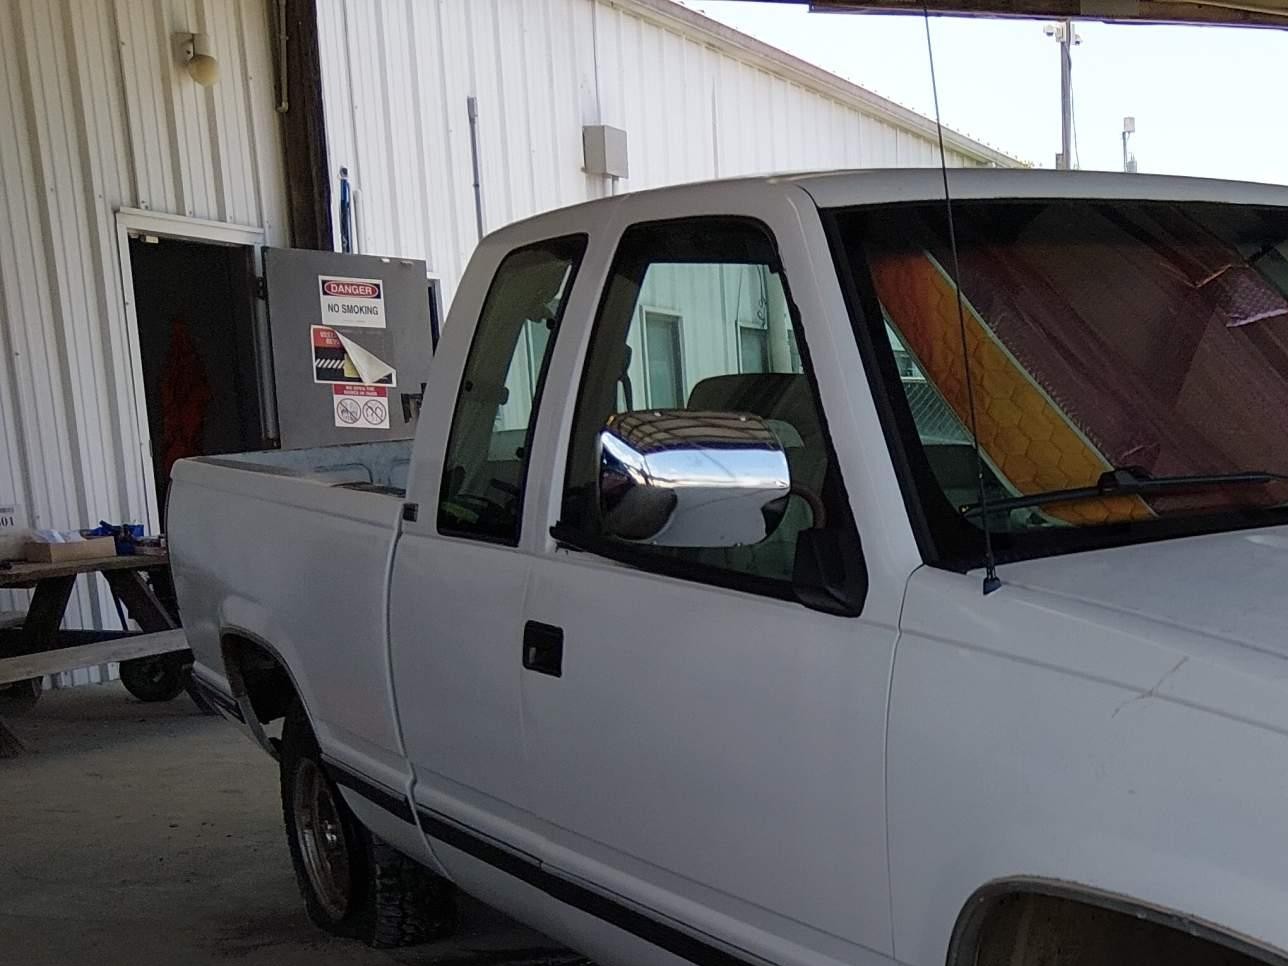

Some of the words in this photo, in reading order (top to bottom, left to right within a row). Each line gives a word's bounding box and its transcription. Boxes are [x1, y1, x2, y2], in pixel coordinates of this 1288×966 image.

[330, 283, 373, 295] DANGER
[327, 303, 340, 313] NO
[341, 304, 379, 316] SMOKING
